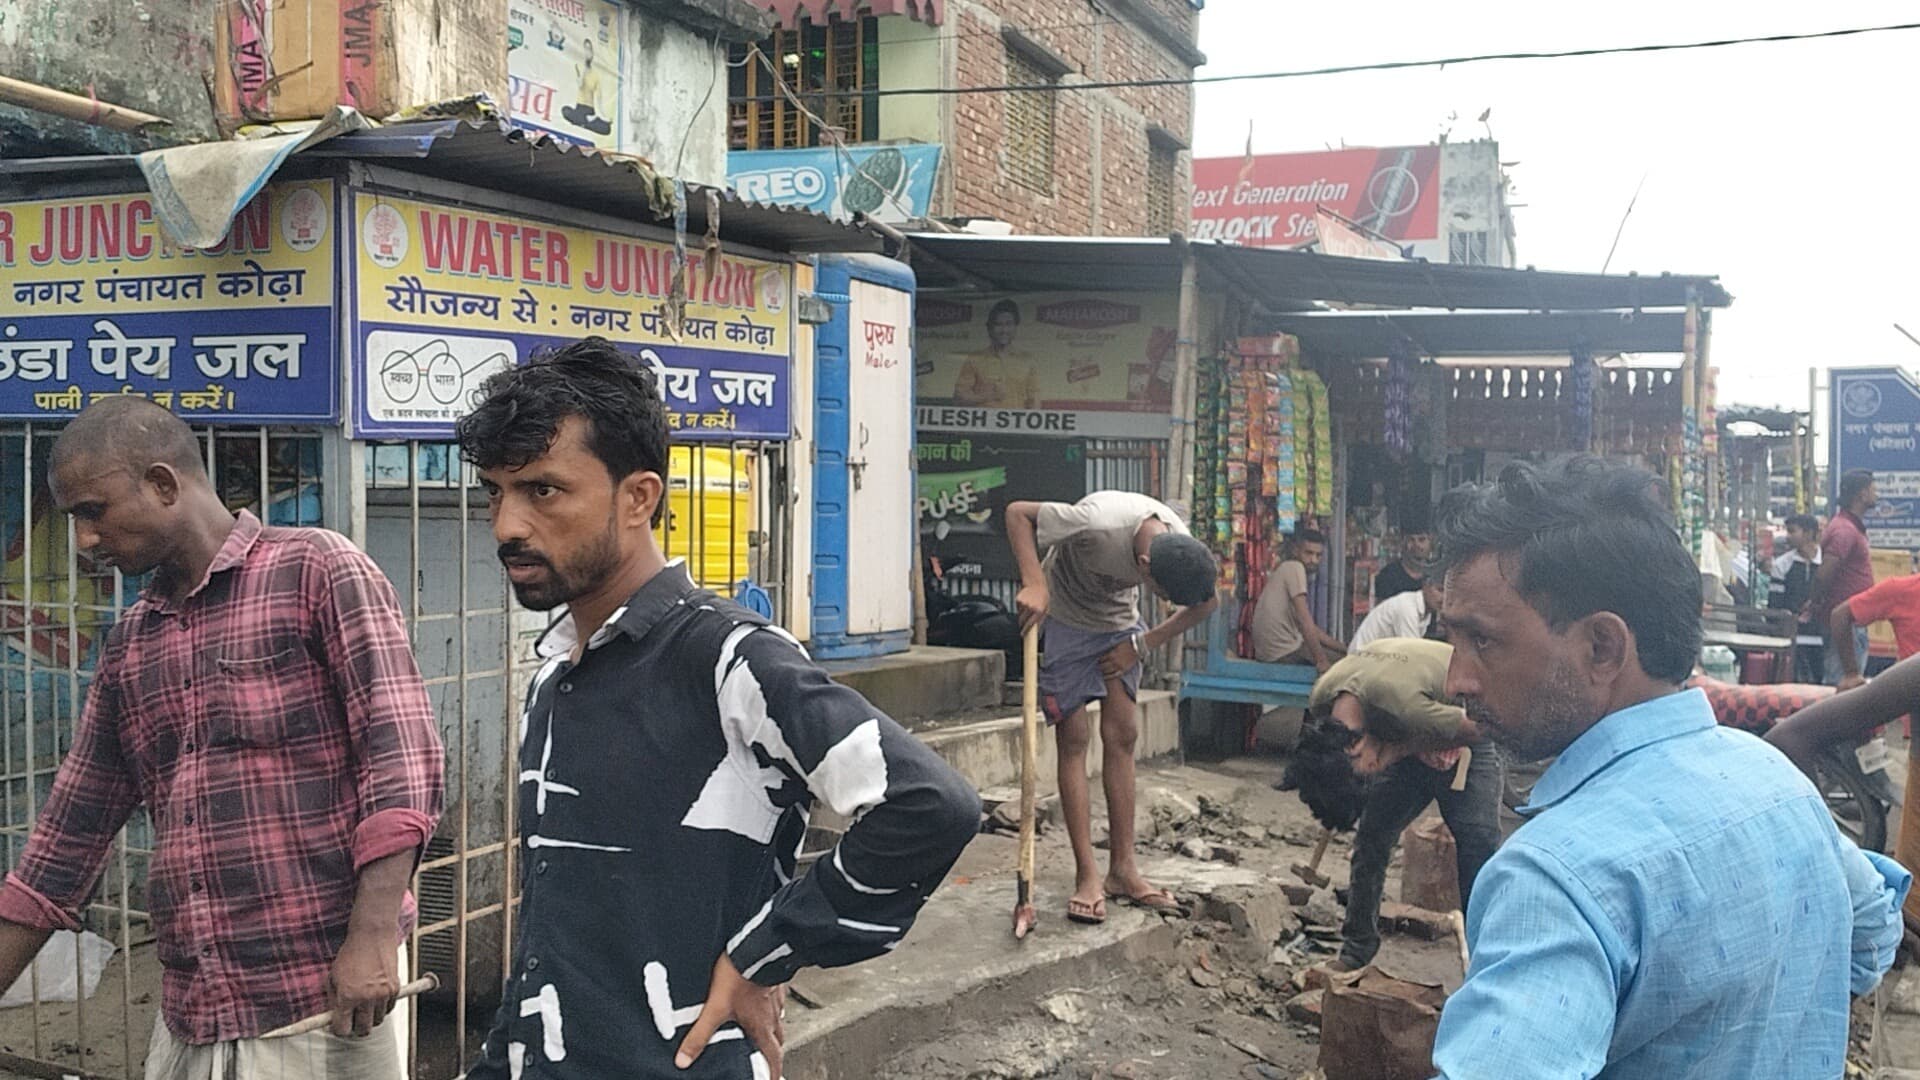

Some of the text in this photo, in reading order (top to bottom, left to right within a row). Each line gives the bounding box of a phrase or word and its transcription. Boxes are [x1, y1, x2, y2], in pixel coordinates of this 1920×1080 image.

[1232, 179, 1349, 205] Generation
[29, 192, 271, 262] JUNCN
[419, 210, 572, 286] WATER
[13, 259, 307, 306] नगर पंचायत कोढ़ा
[385, 276, 502, 321] सौजन्य
[512, 288, 539, 324] से
[569, 304, 632, 333] नगर
[640, 304, 719, 341] पंयत
[723, 314, 776, 351] कोढ़ा
[862, 320, 896, 351] पुरुष
[88, 321, 176, 381] पेय
[193, 334, 306, 379] जल
[34, 386, 83, 411] पानी
[180, 385, 235, 410] करें।
[709, 360, 777, 407] जल
[916, 408, 1077, 431] ILESH STORE
[917, 481, 978, 520] PULSE
